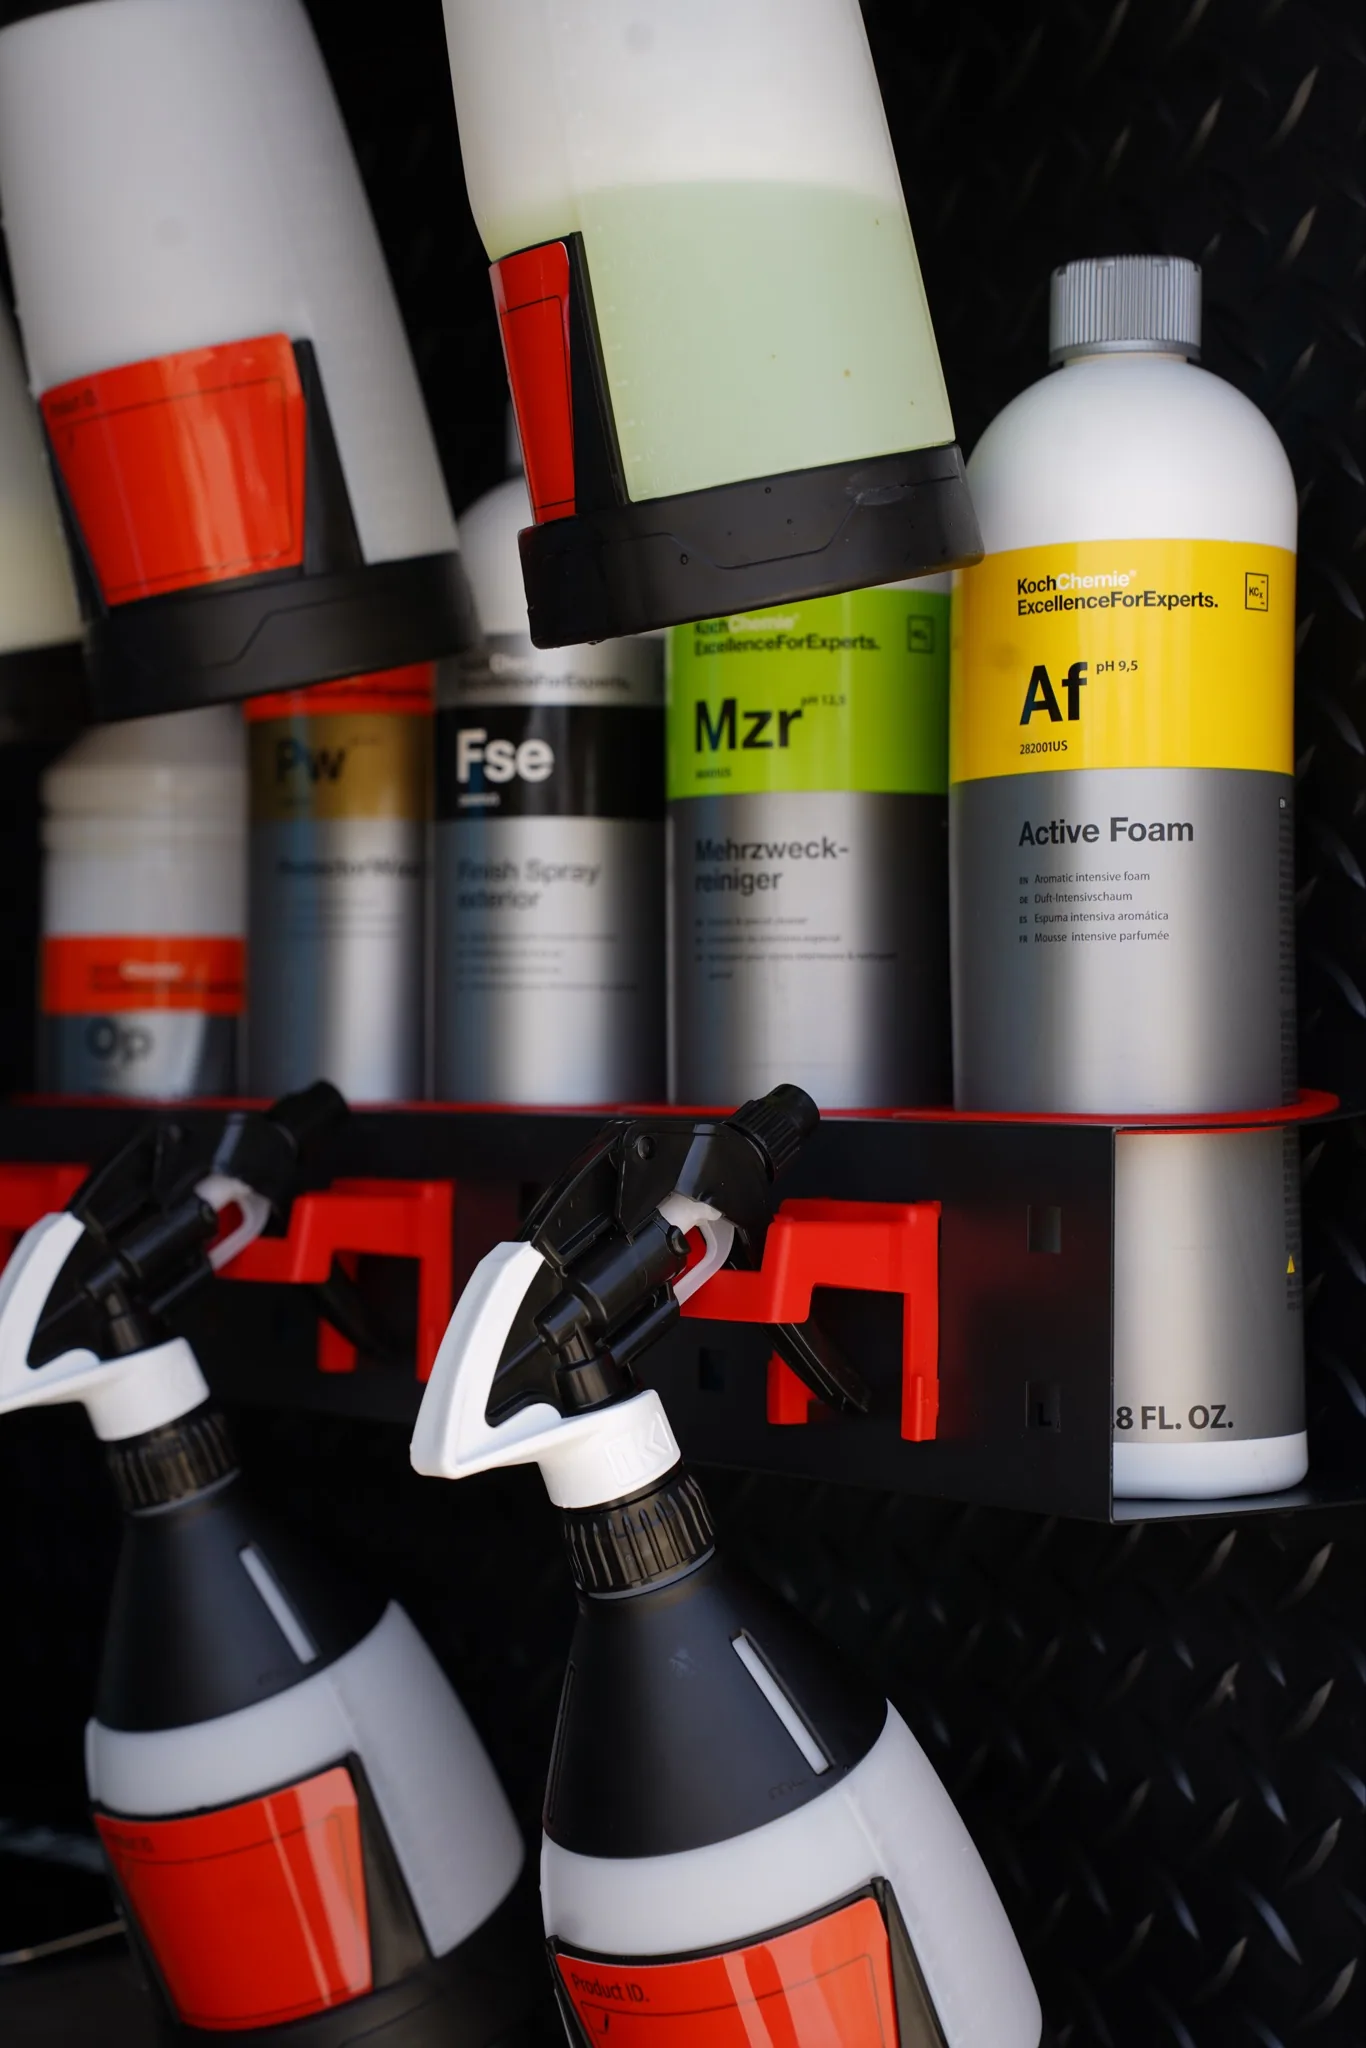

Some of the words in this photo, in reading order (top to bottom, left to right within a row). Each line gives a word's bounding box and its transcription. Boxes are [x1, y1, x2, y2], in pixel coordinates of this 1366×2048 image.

[1017, 590, 1218, 616] ExcellenceForExperts.
[1019, 661, 1088, 726] Af
[1096, 660, 1115, 675] pH
[1118, 660, 1138, 673] 9,5
[695, 697, 803, 752] Mzr
[456, 728, 555, 783] Fse
[1019, 740, 1068, 755] 282001US
[1018, 818, 1100, 847] Active
[1110, 816, 1194, 842] Foam
[695, 837, 849, 861] Mehrzweck-
[695, 868, 783, 897] reiniger
[1034, 873, 1074, 885] Aromatic
[1075, 872, 1122, 883] intensive
[1124, 871, 1150, 882] foam
[1034, 892, 1133, 904] Duft-Intensivschaum
[1034, 913, 1068, 925] Espuma
[1070, 911, 1115, 922] intensiva
[1117, 911, 1169, 921] aromática
[1034, 932, 1067, 944] Mousse
[1071, 931, 1117, 942] intensive
[1119, 930, 1170, 943] parfumée
[1141, 1405, 1182, 1431] FL.
[1188, 1404, 1234, 1431] OZ.
[570, 1972, 625, 2001] Product
[625, 1983, 650, 2002] ID.
